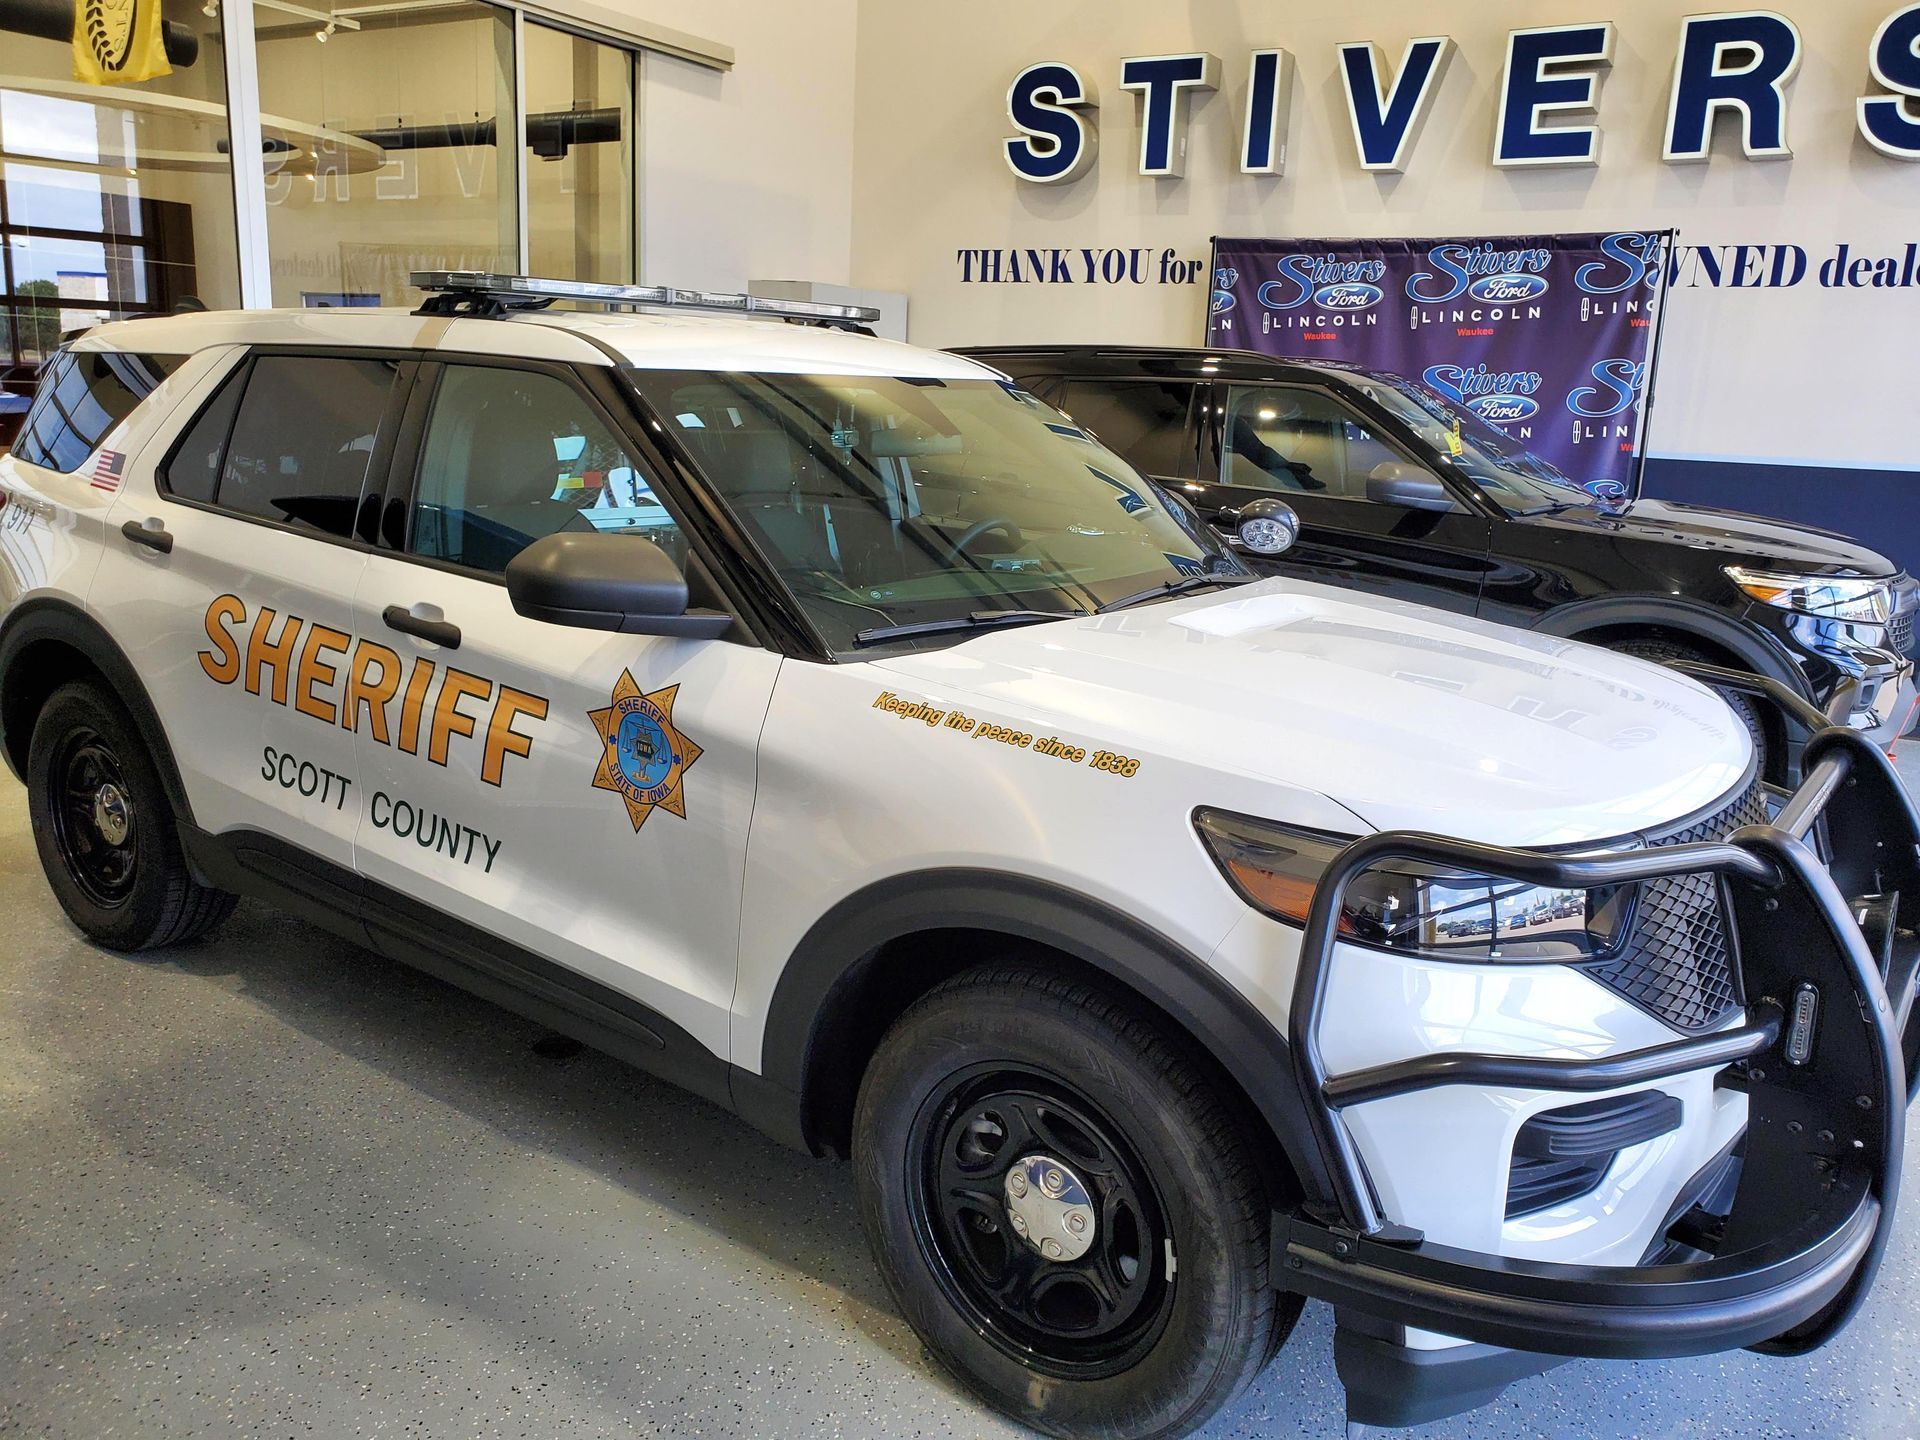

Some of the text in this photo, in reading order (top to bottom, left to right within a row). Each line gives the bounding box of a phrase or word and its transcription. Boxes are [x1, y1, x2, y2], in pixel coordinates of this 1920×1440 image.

[1002, 2, 1920, 185] STIVERS
[957, 248, 1203, 285] THANK YOU for
[1257, 253, 1386, 310] Stivers
[1405, 242, 1552, 303] Stivers
[1818, 243, 1920, 288] deal
[1327, 288, 1368, 306] Ford
[1484, 278, 1532, 298] Ford
[1273, 313, 1377, 329] LINCOLN
[1421, 306, 1541, 324] LINCOLN
[1456, 327, 1495, 337] Waukee
[1303, 332, 1337, 342] Waukee
[1422, 363, 1543, 405] Stivers
[1477, 398, 1525, 418] Ford
[197, 593, 550, 789] SHERIFF
[618, 699, 664, 725] SHERIFF
[872, 691, 1140, 777] Keeping the peace since 1838
[610, 763, 671, 802] STATE OF IOWA
[261, 746, 502, 874] SCOTT COUNTY
